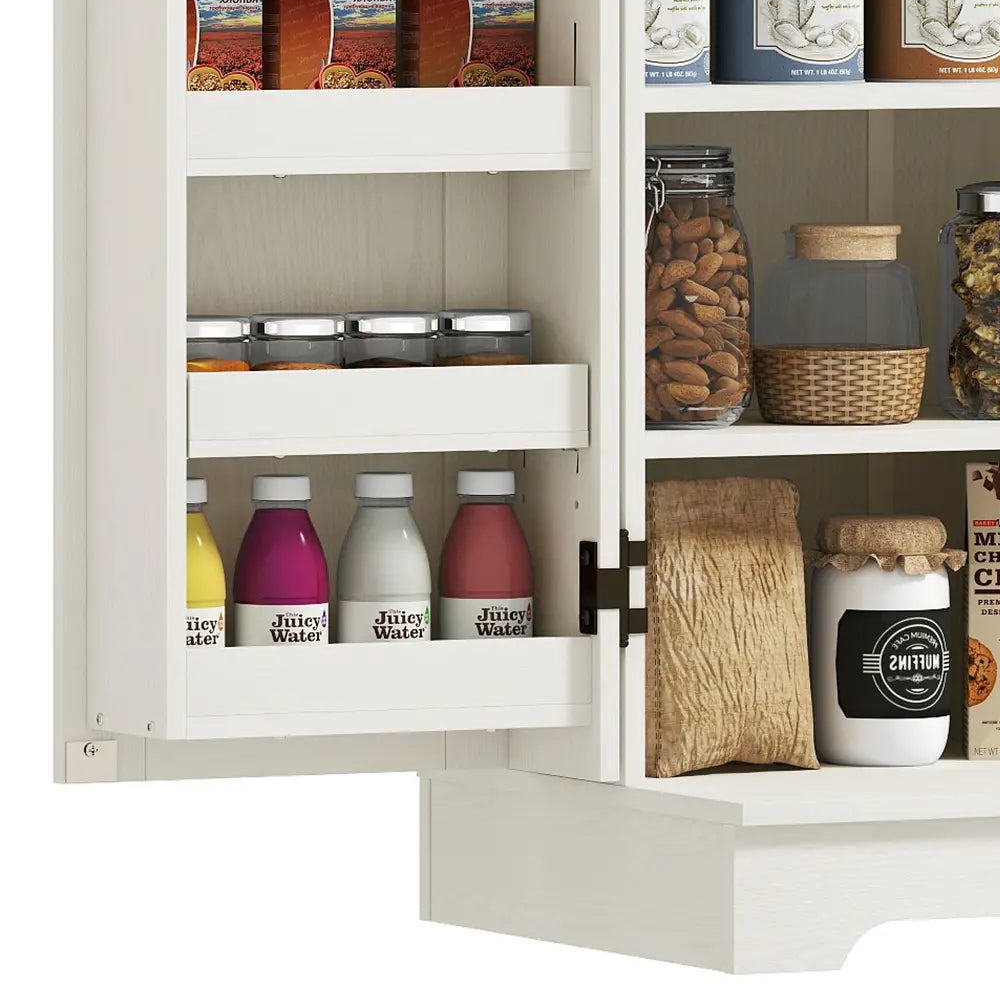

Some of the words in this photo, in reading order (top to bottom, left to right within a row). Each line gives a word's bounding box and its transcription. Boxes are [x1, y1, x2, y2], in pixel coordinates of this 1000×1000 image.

[272, 614, 320, 630] Juicy
[375, 610, 424, 627] Juicy
[477, 607, 526, 624] Juicy
[270, 629, 322, 642] Water
[373, 625, 425, 639] Water
[475, 622, 527, 636] Water
